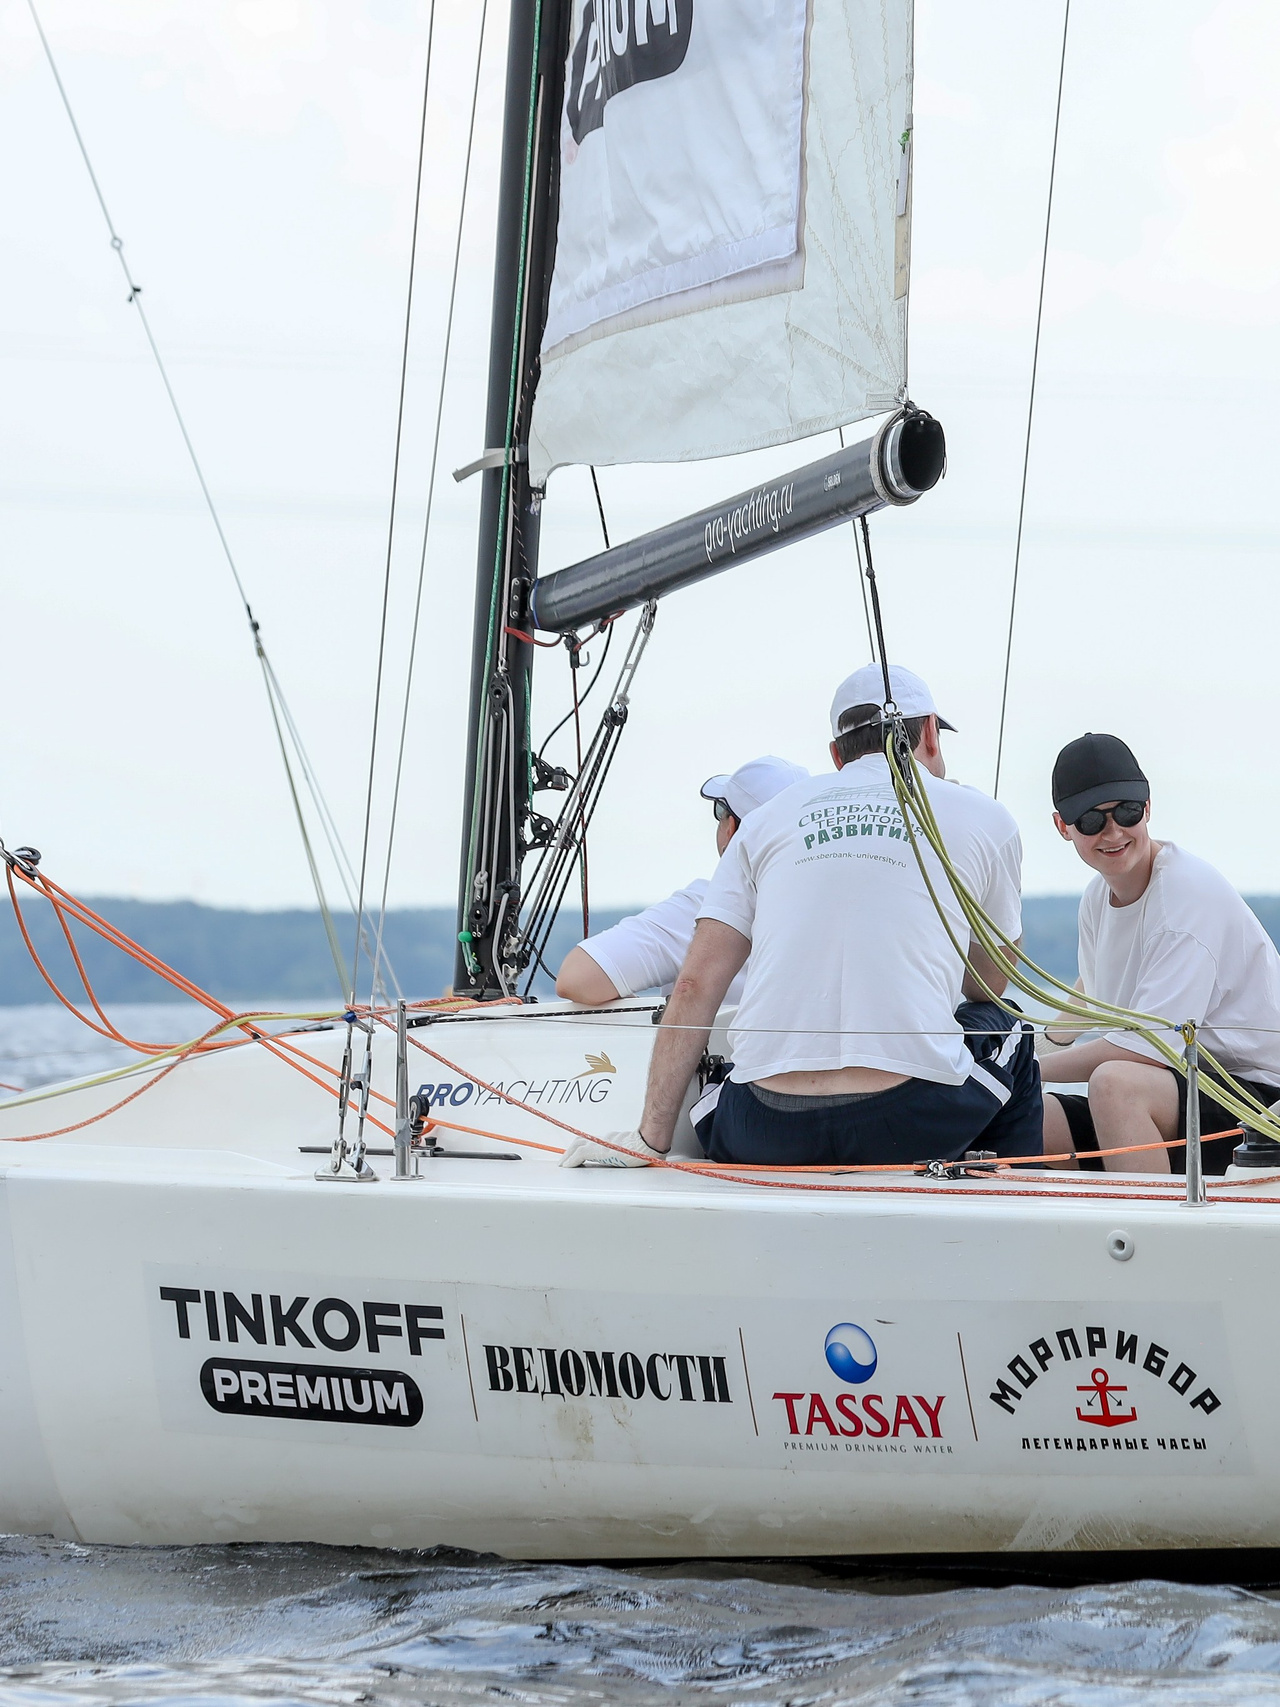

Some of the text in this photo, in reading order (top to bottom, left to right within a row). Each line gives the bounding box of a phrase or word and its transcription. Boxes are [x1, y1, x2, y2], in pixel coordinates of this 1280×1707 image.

[704, 482, 794, 563] pro-yachting.ru
[798, 803, 904, 828] СБЕРБАНК
[794, 851, 907, 868] www.sberbank-university.ru
[159, 1286, 445, 1356] TINKOFF
[211, 1367, 410, 1416] PREMIUM
[482, 1344, 734, 1403] ВЕДОМОСТИ
[989, 1326, 1222, 1416] МОРПРИБОР
[771, 1392, 947, 1439] TASSAY
[783, 1441, 954, 1455] PREMIUM DRINKING WATER
[1021, 1437, 1207, 1452] ЛЕГЕНДАРНЫЕ ЧАСЫ
